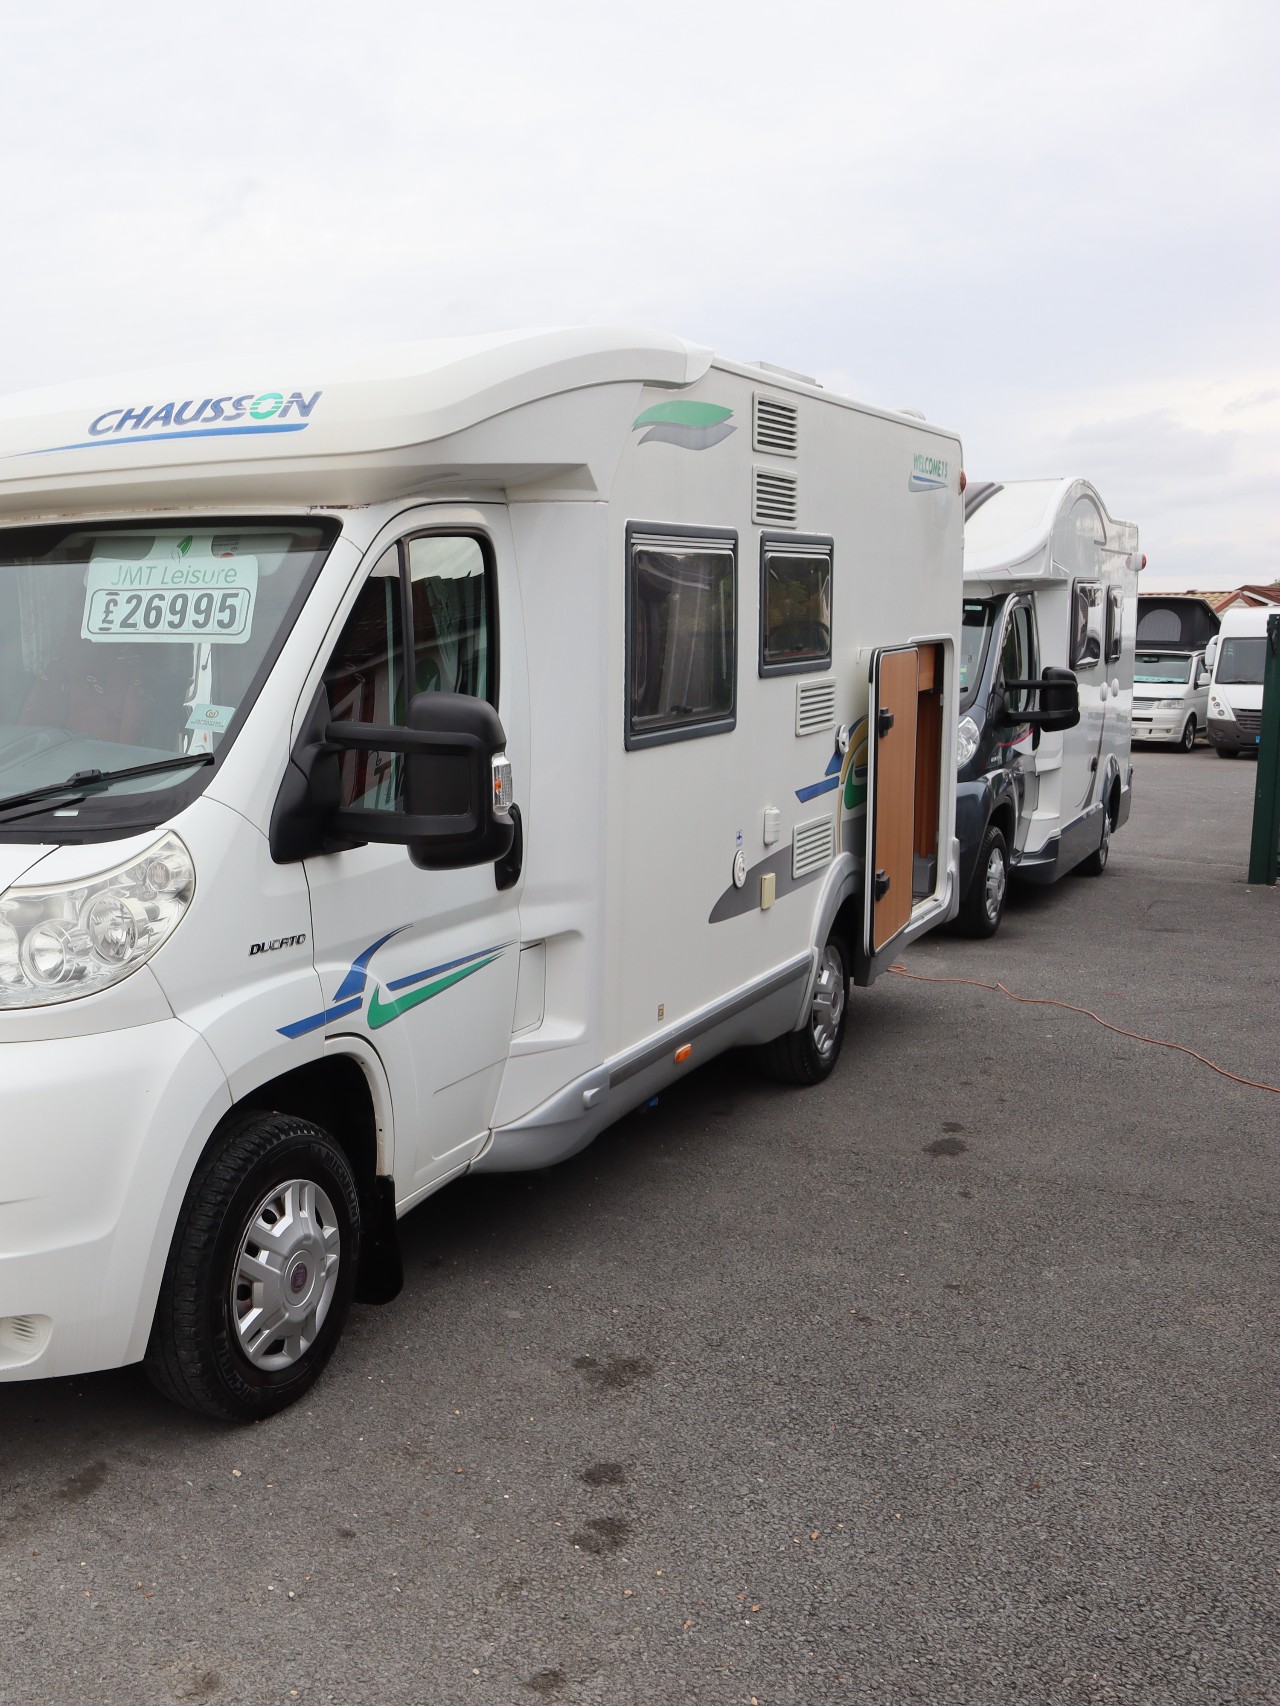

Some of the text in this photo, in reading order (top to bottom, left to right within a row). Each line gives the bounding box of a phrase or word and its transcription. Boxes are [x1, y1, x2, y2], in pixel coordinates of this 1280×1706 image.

[88, 391, 323, 436] CHAUSSON
[111, 565, 238, 586] JMT Leisure
[101, 592, 240, 630] £26995
[248, 933, 306, 956] DUCATO
